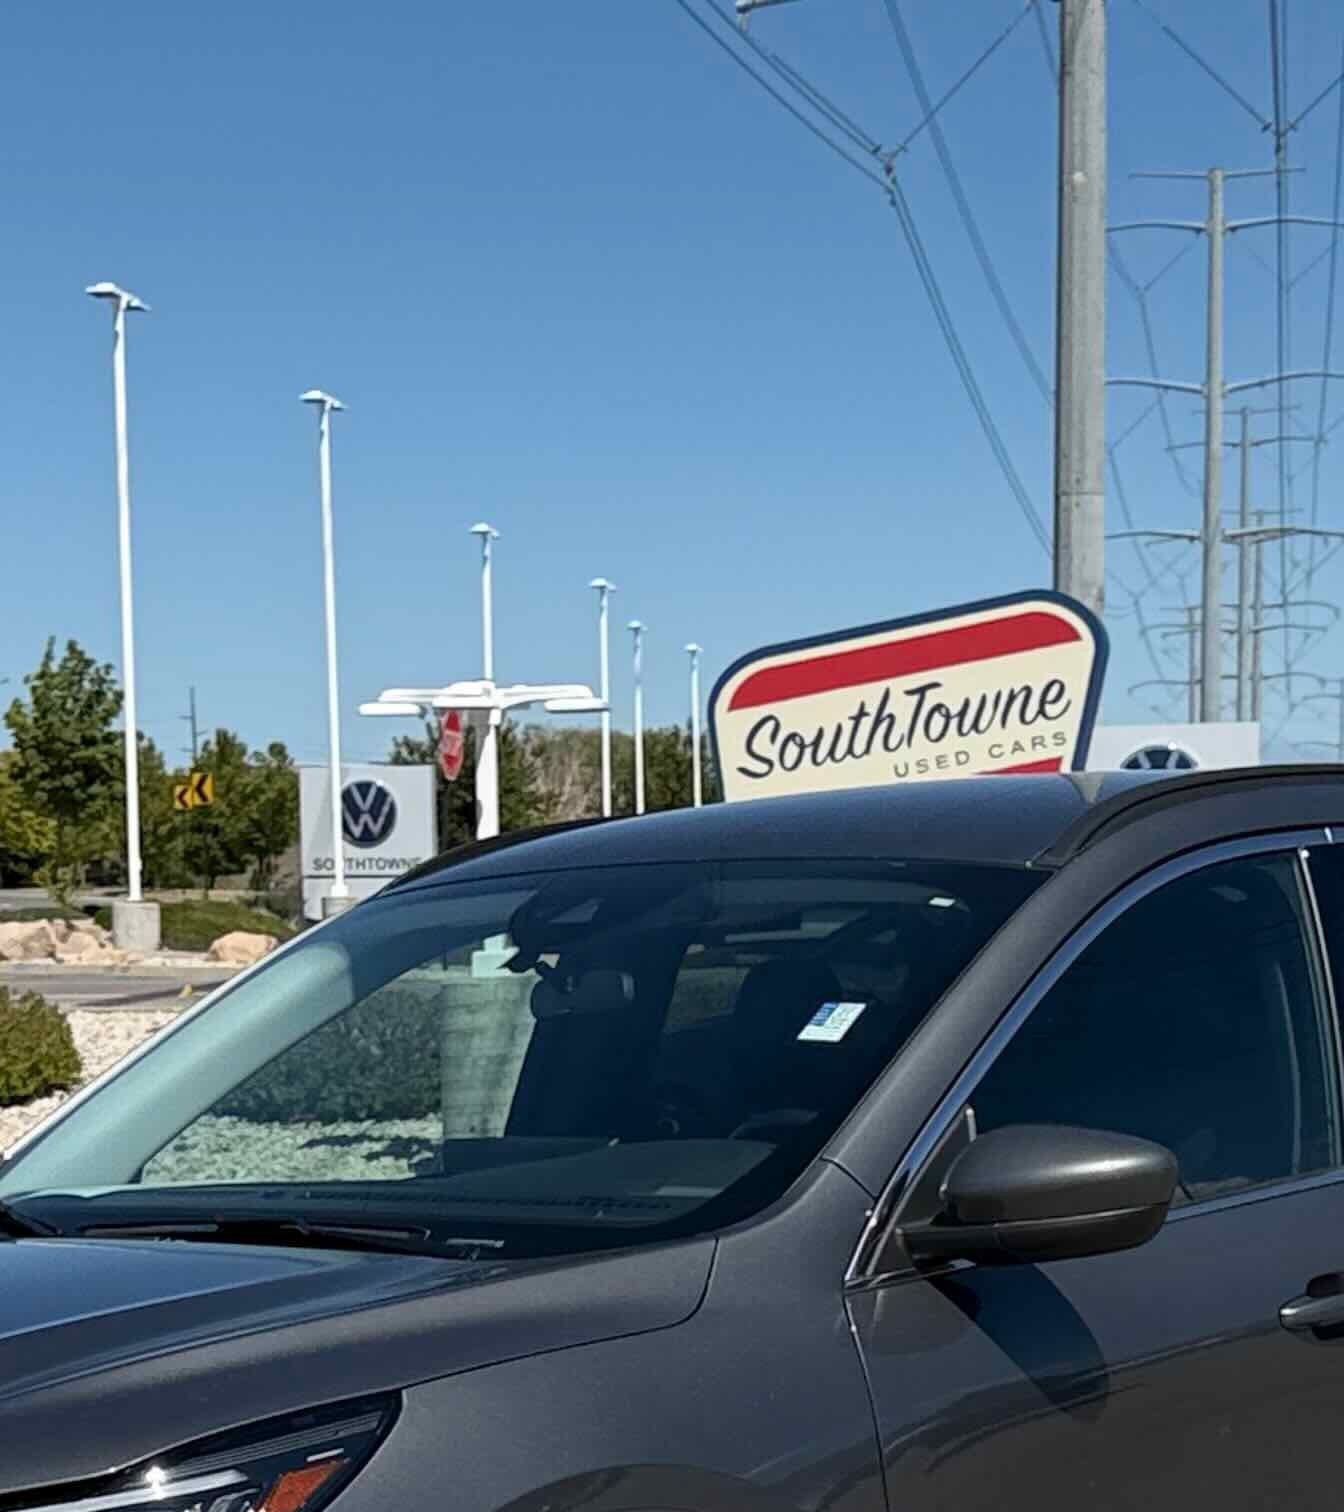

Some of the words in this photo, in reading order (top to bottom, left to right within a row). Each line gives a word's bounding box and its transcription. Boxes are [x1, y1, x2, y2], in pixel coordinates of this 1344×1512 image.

[736, 678, 1071, 778] SouthTowne
[893, 749, 971, 778] USED
[988, 731, 1067, 760] CARS
[312, 857, 422, 871] SOTHTOWN
